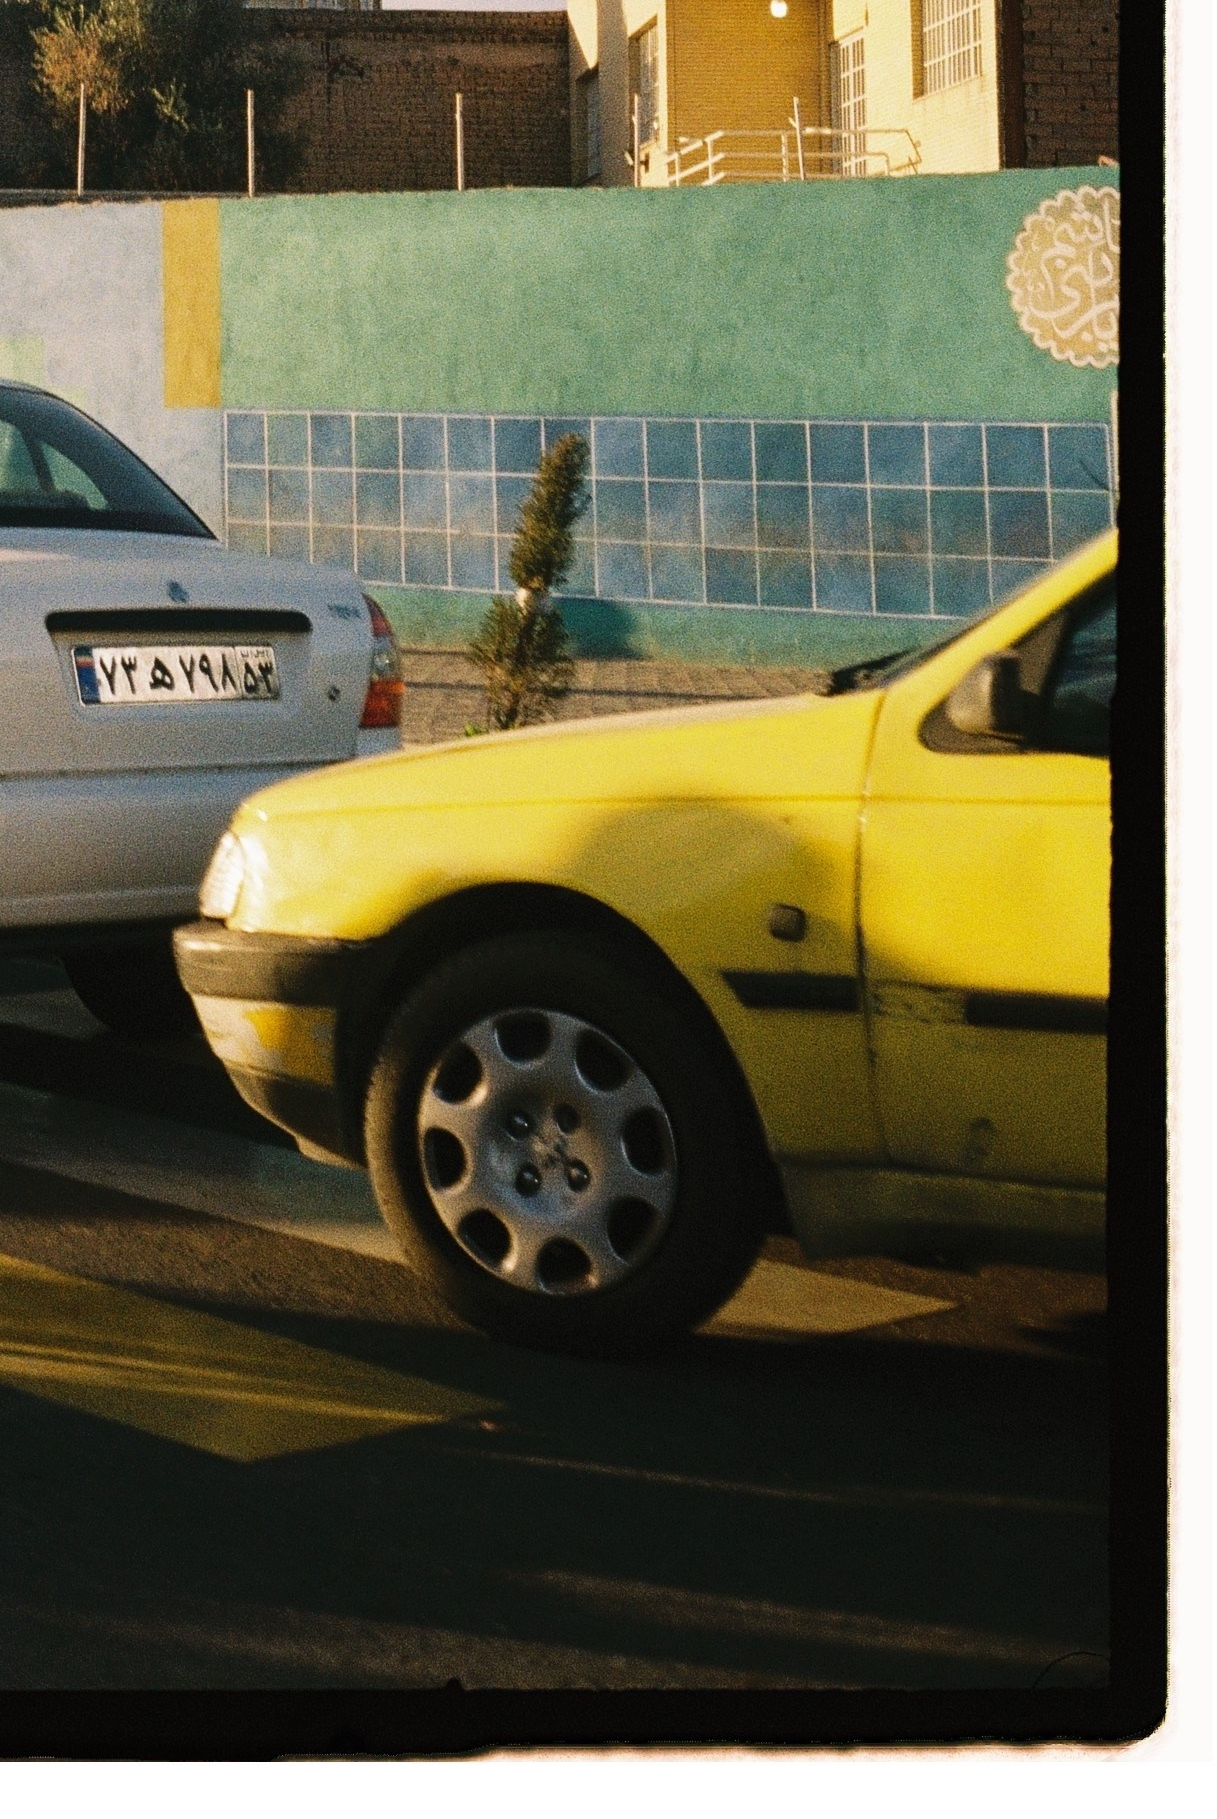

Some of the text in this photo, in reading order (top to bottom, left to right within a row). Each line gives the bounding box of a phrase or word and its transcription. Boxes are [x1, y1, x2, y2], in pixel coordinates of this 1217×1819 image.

[98, 653, 137, 695] ۷۳
[179, 653, 239, 694] ۷۹۸
[244, 661, 274, 695] ۵۳
